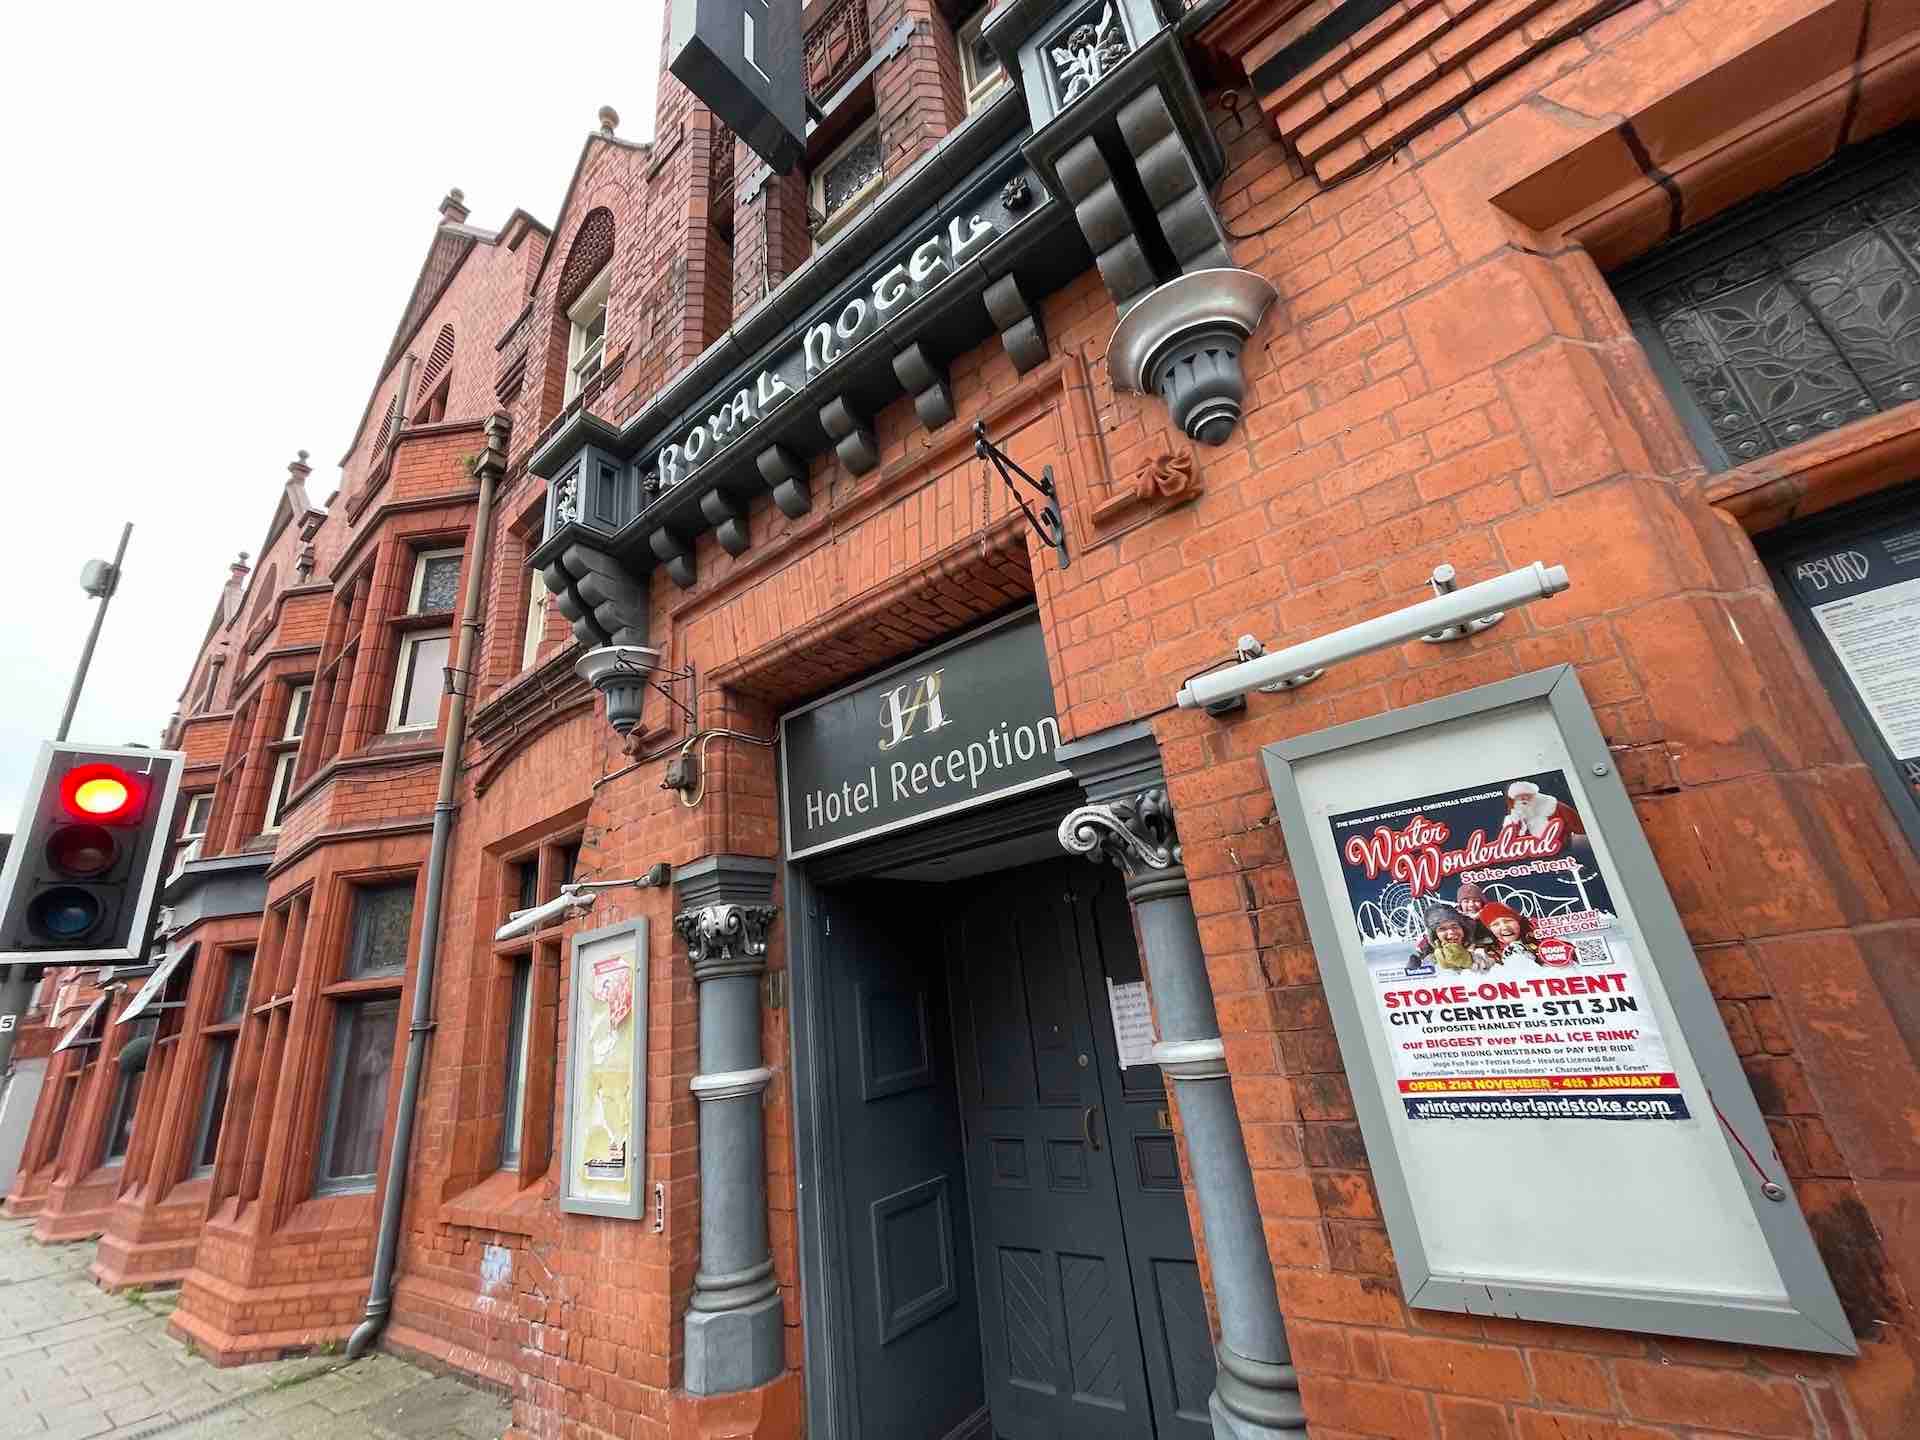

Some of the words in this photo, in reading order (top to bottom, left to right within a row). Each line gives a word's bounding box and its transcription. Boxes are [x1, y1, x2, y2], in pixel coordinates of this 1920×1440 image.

[659, 370, 788, 490] ROYAL
[803, 214, 994, 371] HOTEL
[1797, 551, 1869, 590] ABSURD
[807, 766, 879, 830] Hotel
[890, 716, 1061, 802] Reception
[1348, 817, 1448, 877] Winter
[1394, 819, 1560, 895] Wonderland
[1461, 857, 1580, 884] Stoke-on-Trent
[1541, 945, 1567, 954] BOOK
[1383, 973, 1627, 1009] STOKE-ON-TRENT
[1389, 1008, 1434, 1026] CITY
[1439, 1003, 1525, 1023] CENTRE
[1543, 1001, 1584, 1017] ST1
[1591, 996, 1638, 1014] 3JN
[1421, 1024, 1477, 1035] (OPPOSITE
[1477, 1020, 1521, 1031] HANLEY
[1524, 1020, 1547, 1028] BUS
[1549, 1016, 1606, 1027] STATION)
[1402, 1040, 1424, 1050] our
[1426, 1036, 1483, 1049] BIGGEST
[1487, 1036, 1518, 1046] ever
[1567, 1031, 1594, 1042] ICE
[1413, 1050, 1460, 1060] UNLIMITED
[1461, 1048, 1493, 1058] RIDING
[1493, 1046, 1552, 1057] WRISTBAND
[1566, 1046, 1585, 1054] PAY
[1587, 1045, 1607, 1053] PER
[1610, 1043, 1636, 1053] RIDE
[1408, 1081, 1446, 1091] OPEN:
[1448, 1081, 1473, 1090] 21st
[1474, 1078, 1551, 1089] NOVEMBER
[1562, 1078, 1588, 1088] 4th
[1591, 1076, 1661, 1088] JANUARY
[1416, 1098, 1671, 1114] winterwonderlandstoke.com
